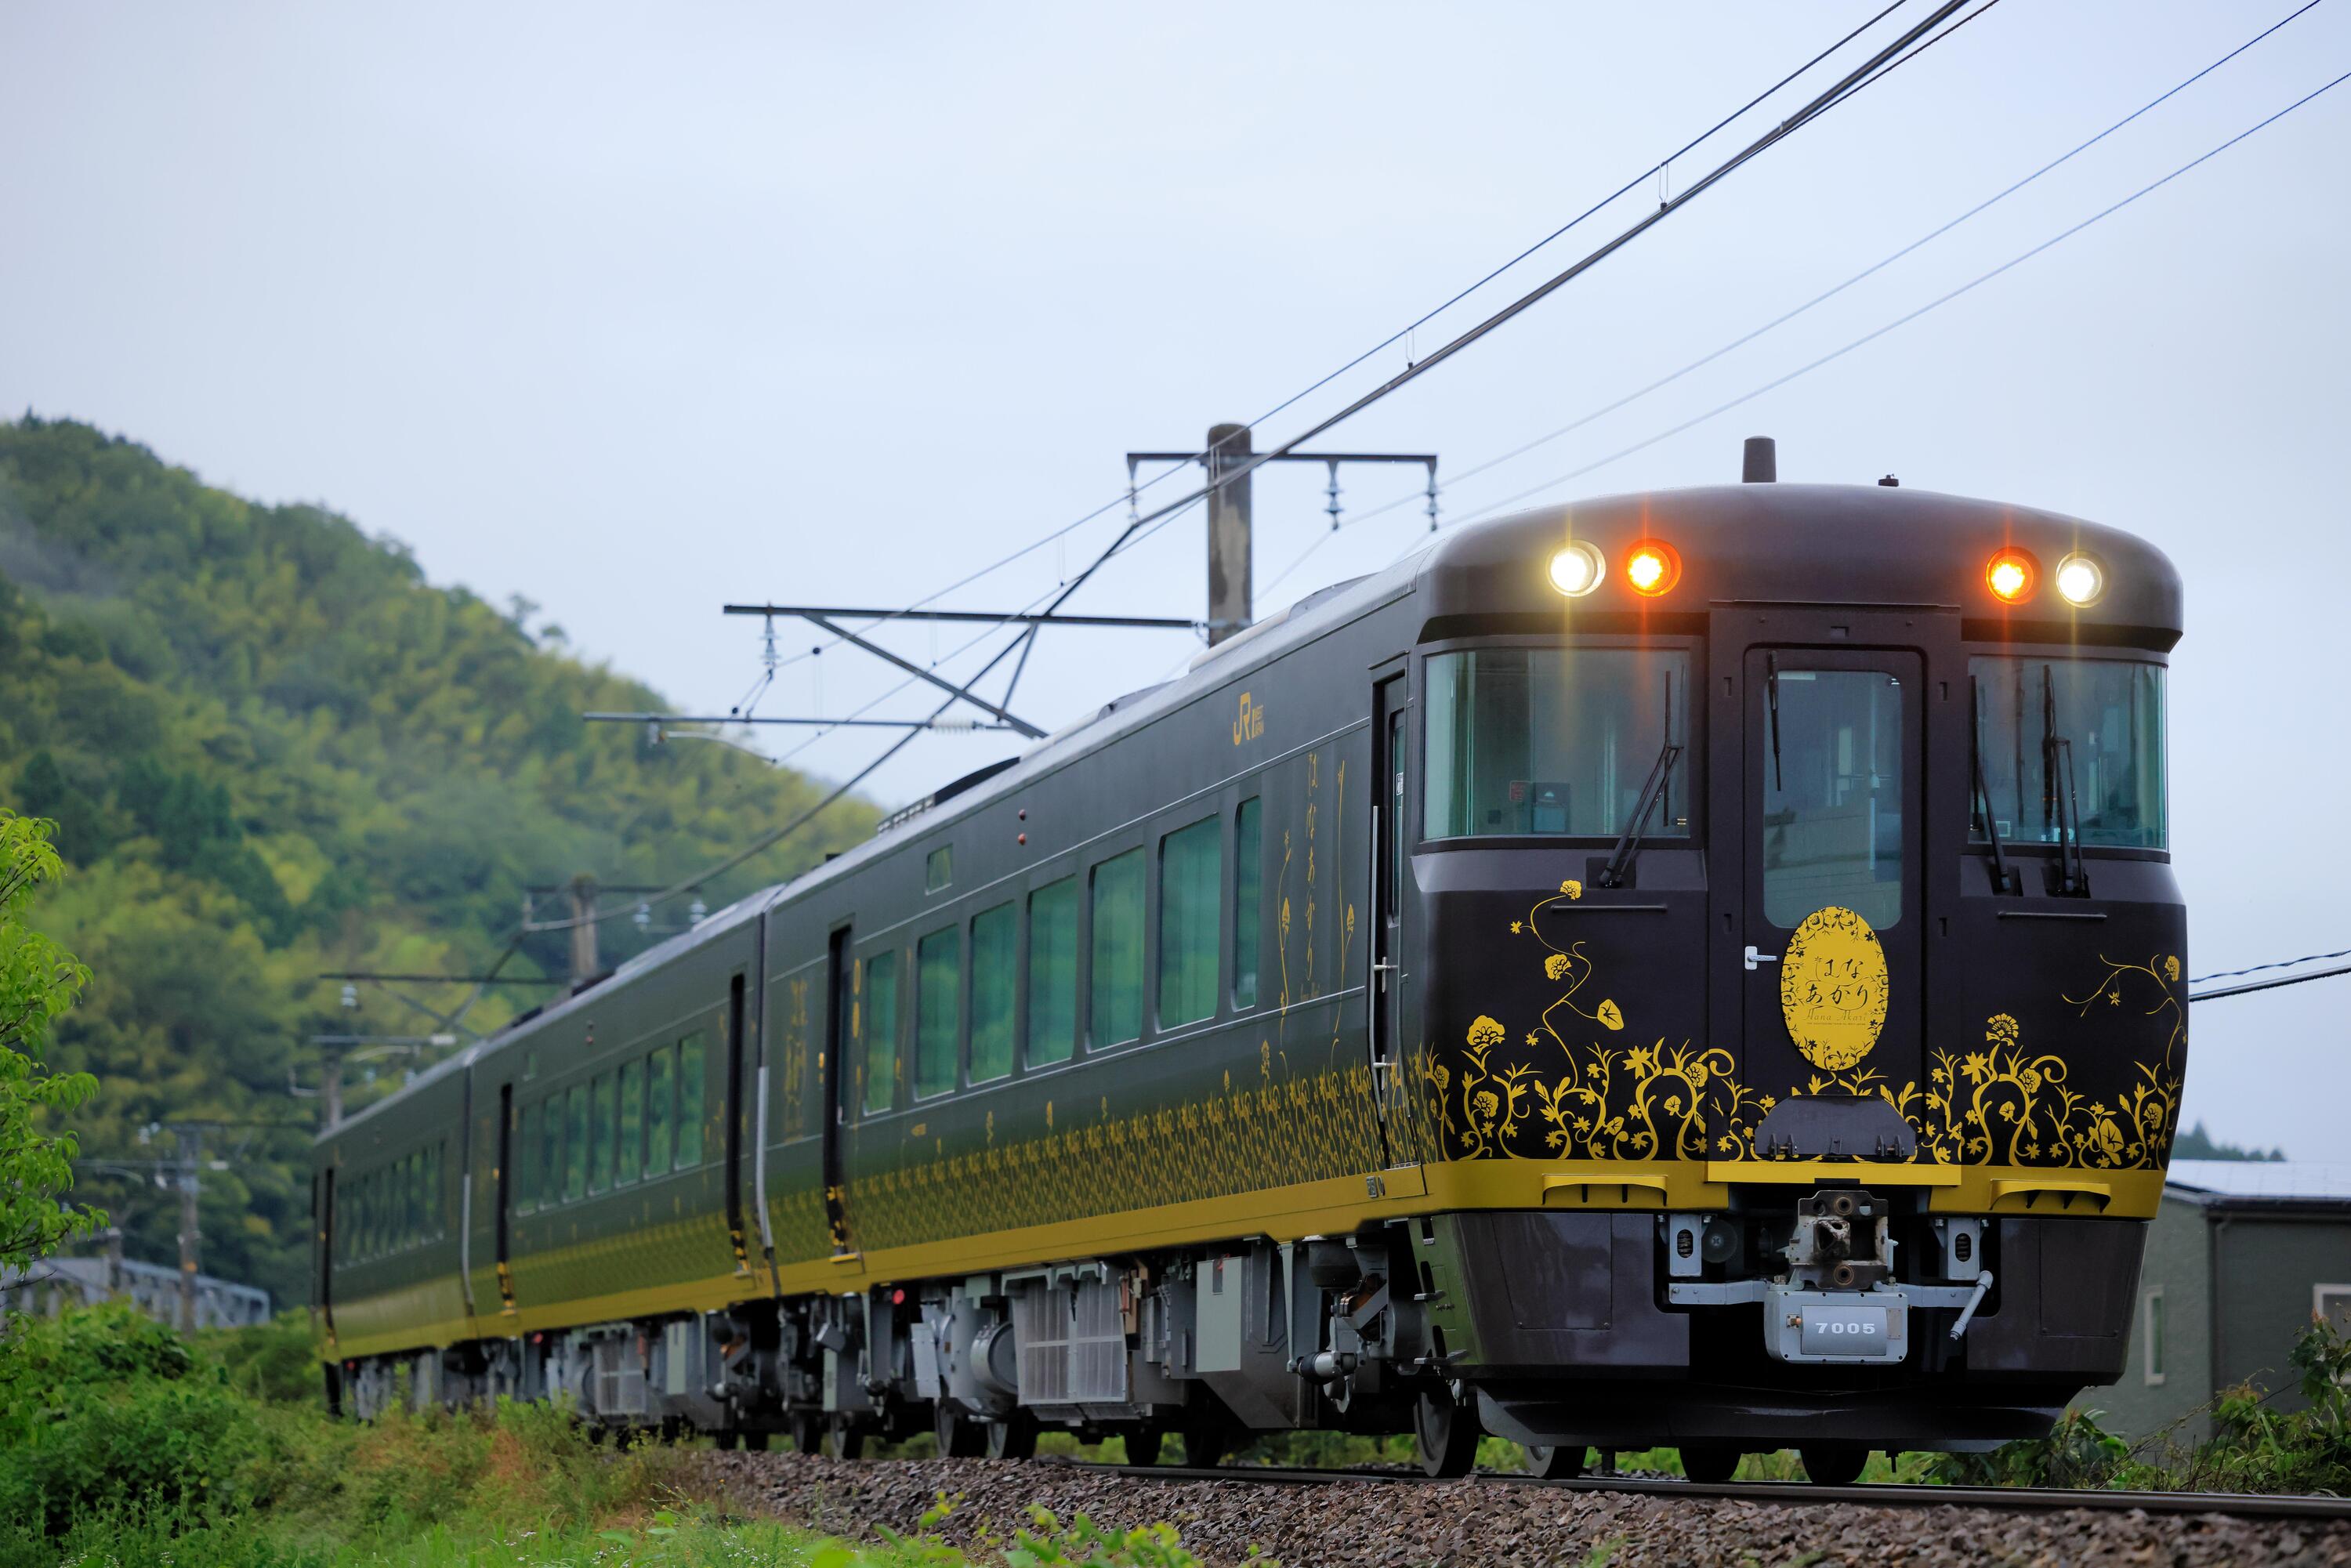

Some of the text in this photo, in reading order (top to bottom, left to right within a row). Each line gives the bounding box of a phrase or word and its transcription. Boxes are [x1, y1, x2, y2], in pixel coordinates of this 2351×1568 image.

[1814, 957, 1864, 981] はな
[1805, 983, 1868, 1007] あかり
[1802, 1009, 1831, 1021] Hana
[1815, 1322, 1875, 1334] 7005
